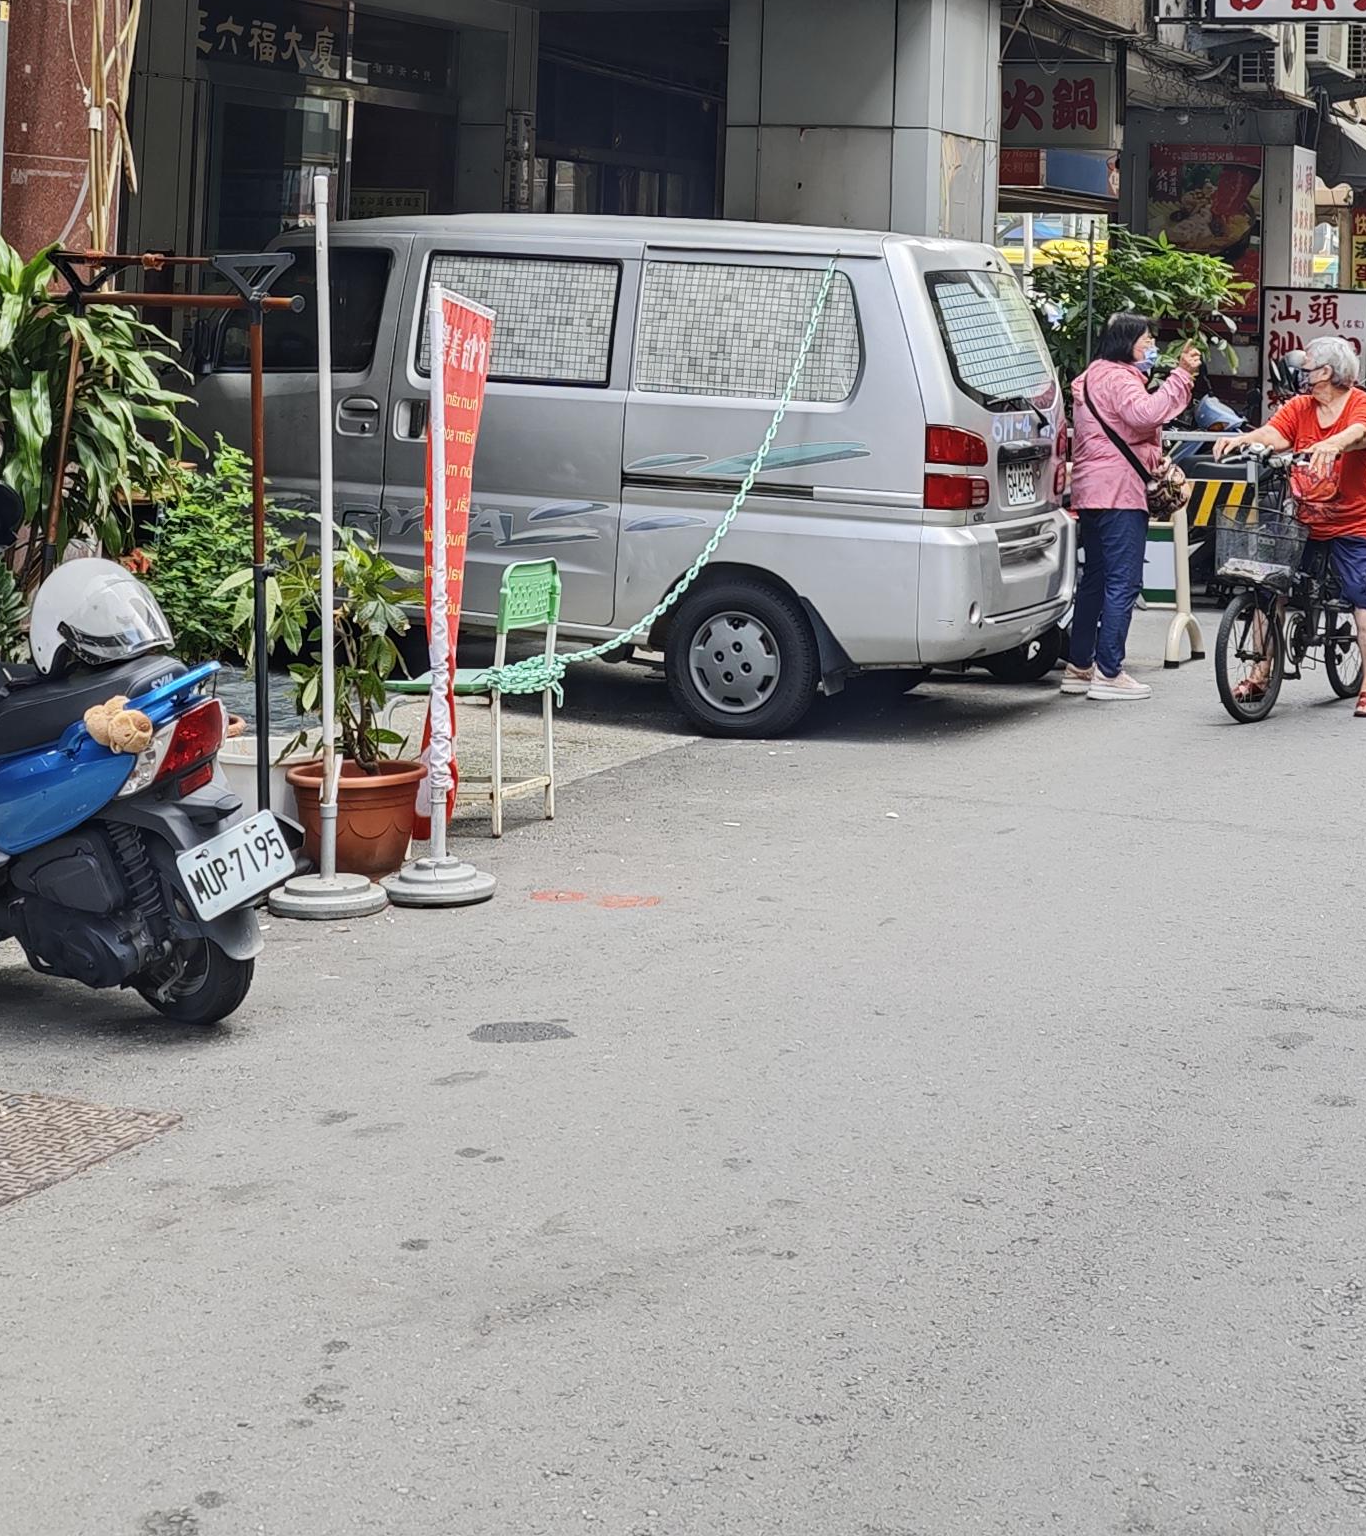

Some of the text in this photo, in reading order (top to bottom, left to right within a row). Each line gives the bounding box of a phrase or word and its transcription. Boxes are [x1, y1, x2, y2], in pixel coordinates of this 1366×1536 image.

[1001, 77, 1098, 132] 火鍋
[1269, 293, 1340, 330] 汕頭
[150, 674, 174, 691] SYM
[187, 827, 286, 905] MUP-7195
